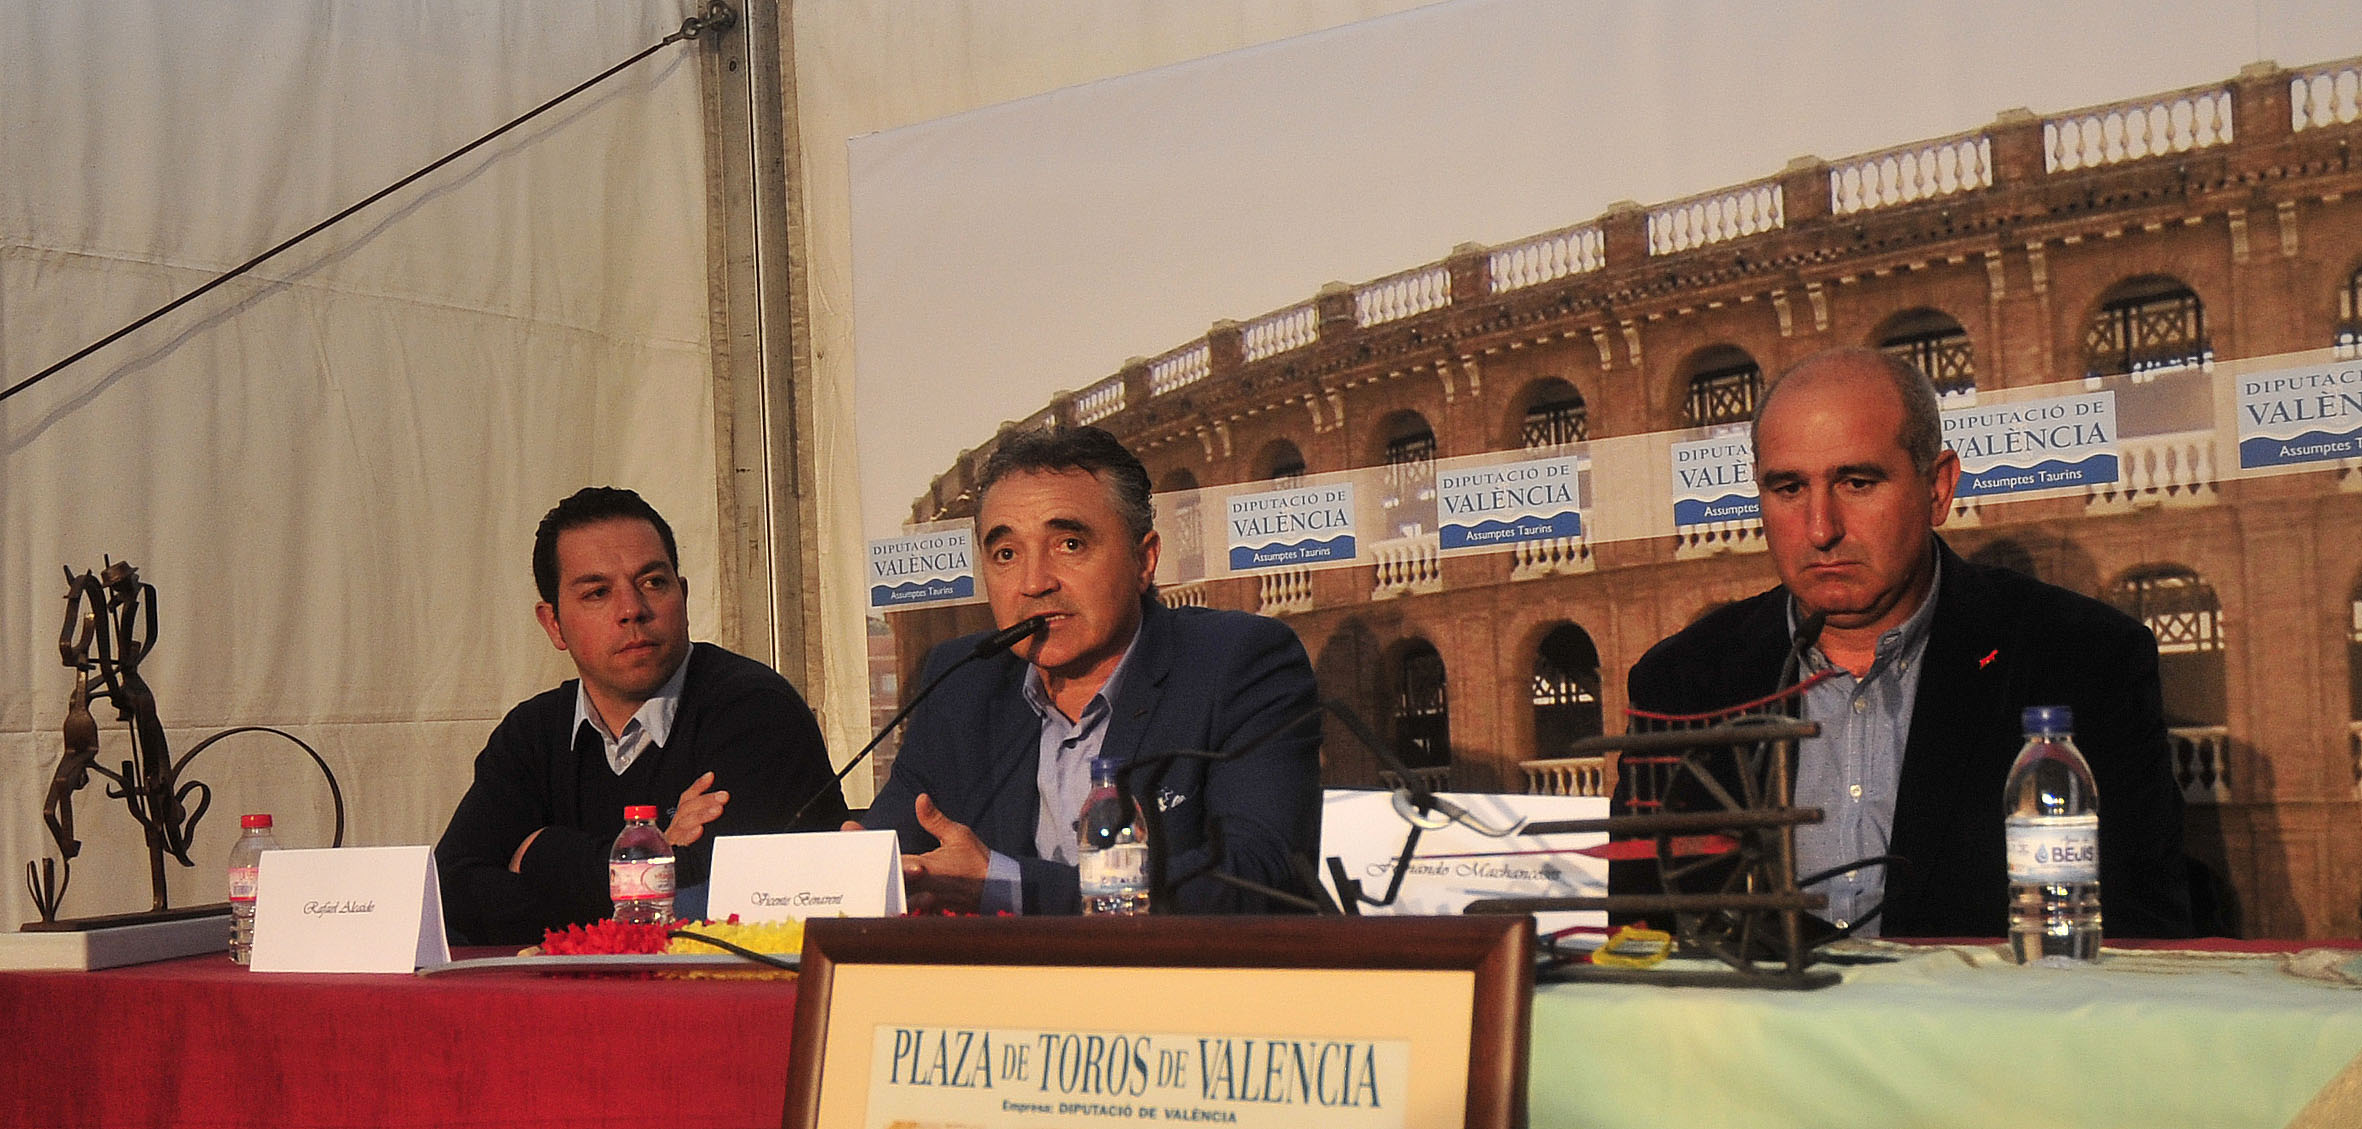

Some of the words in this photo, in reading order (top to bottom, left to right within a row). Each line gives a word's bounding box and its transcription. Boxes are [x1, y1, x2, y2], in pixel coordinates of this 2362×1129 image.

[1944, 404, 2064, 431] DIPUTACIÓ
[2076, 401, 2104, 416] DE
[1943, 422, 2108, 458] VALÈNCIA
[2280, 442, 2351, 457] Assumptes
[1443, 467, 1538, 489] DIPUTACIÓ
[1547, 464, 1570, 477] DE
[1972, 474, 2035, 490] Assumptes
[2037, 469, 2083, 483] Taurins
[1233, 493, 1318, 513] DIPUTACIÓ
[1326, 491, 1346, 502] DE
[1444, 483, 1573, 514] VALÈNCIA
[1704, 504, 1760, 517] Assumptes
[1233, 508, 1349, 537] VALÈNCIA
[1466, 530, 1515, 541] Assumptes
[1518, 524, 1553, 536] Taurins
[873, 537, 944, 555] DIPUTACIÓ
[948, 536, 966, 546] DE
[1253, 551, 1298, 563] Assumptes
[1299, 547, 1331, 558] Taurins
[874, 551, 968, 576] VALÈNCIA
[750, 891, 791, 907] Vicente
[890, 1029, 993, 1089] PLAZA
[1001, 1043, 1031, 1081] DE
[1039, 1033, 1152, 1097] TOROS
[1157, 1050, 1190, 1089] DE
[1197, 1038, 1382, 1108] VALENCIA
[1059, 1102, 1132, 1118] DIPUTACIÓ
[1139, 1107, 1157, 1119] DE
